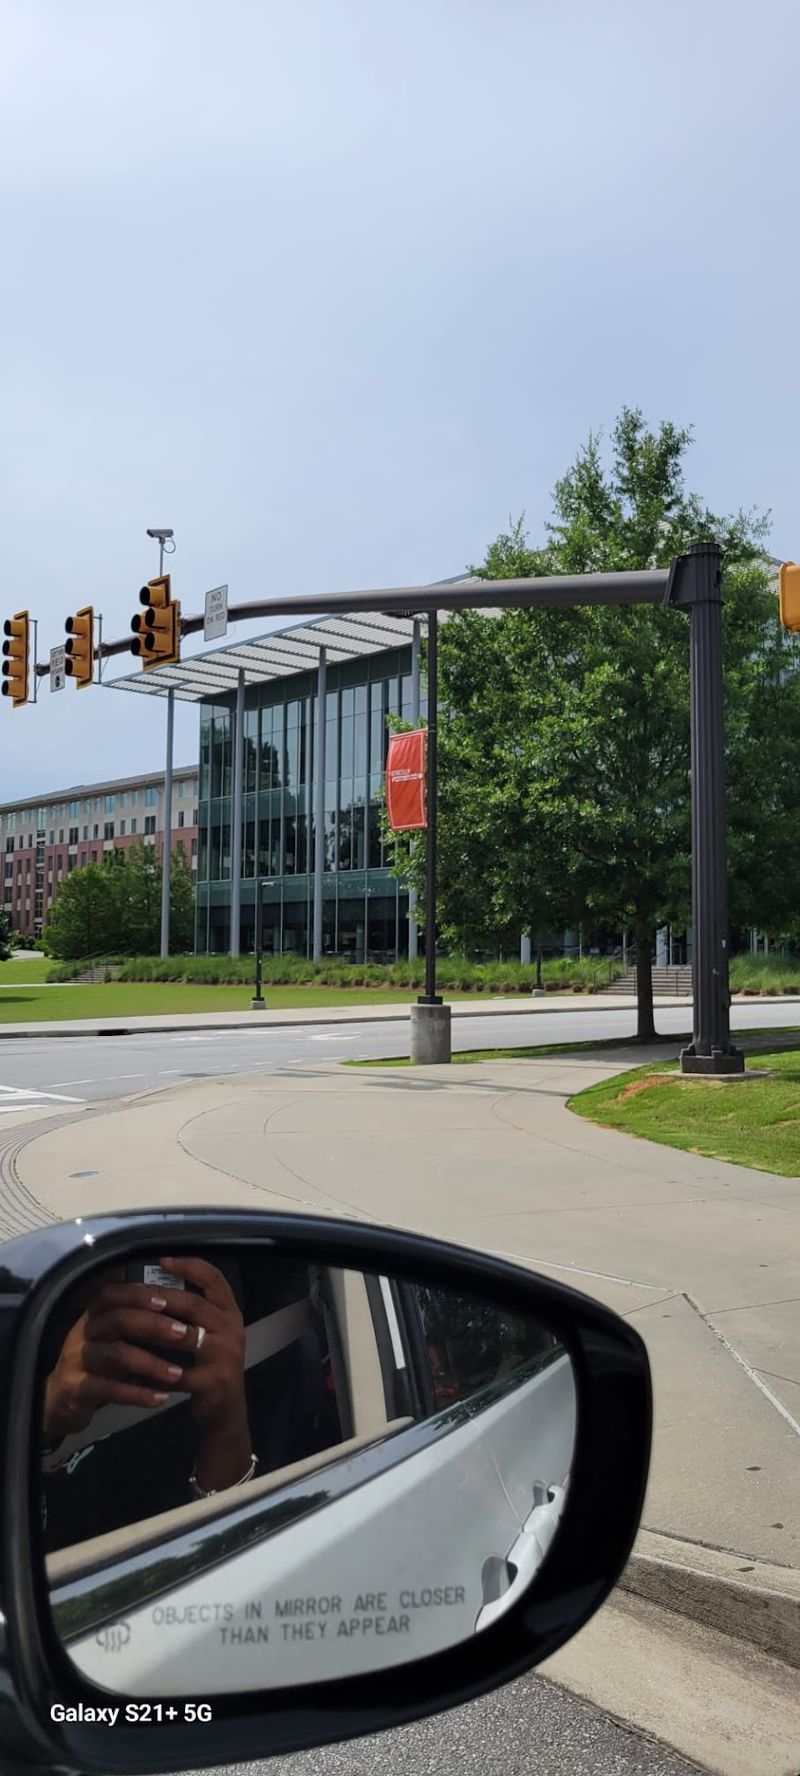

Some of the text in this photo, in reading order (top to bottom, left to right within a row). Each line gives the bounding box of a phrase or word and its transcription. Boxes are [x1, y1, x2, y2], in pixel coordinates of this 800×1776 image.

[211, 591, 222, 603] NO
[207, 611, 225, 624] ON RED
[152, 1586, 465, 1626] OBJECTS IN MIRROR ARE CLOSER
[219, 1614, 410, 1645] THAN THEY APPEAR
